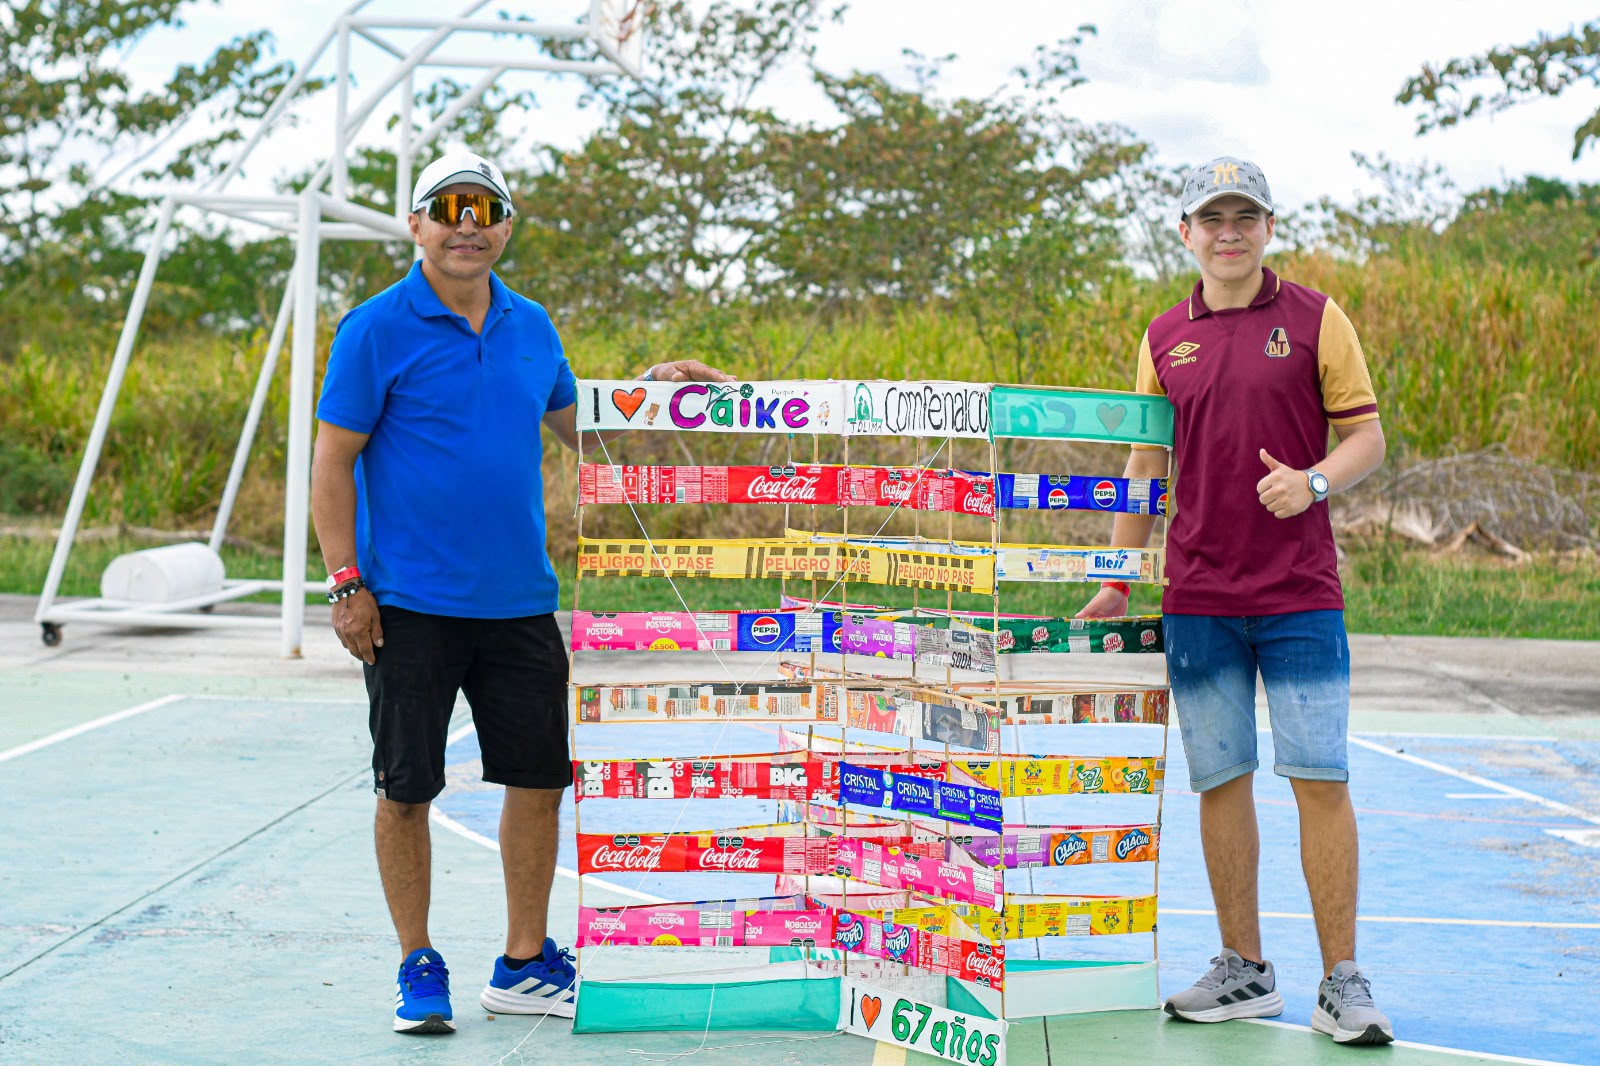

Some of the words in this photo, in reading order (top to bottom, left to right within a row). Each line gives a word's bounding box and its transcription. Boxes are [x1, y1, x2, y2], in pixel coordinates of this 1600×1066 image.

[1171, 356, 1196, 368] umbro
[594, 388, 600, 424] I
[885, 386, 988, 433] Comfenalco
[850, 422, 882, 433] TOLIMA
[747, 476, 820, 500] Coca-Cola
[578, 556, 645, 569] PELIGRO
[650, 557, 671, 569] NO
[678, 557, 714, 570] PASE
[766, 558, 830, 571] PELIGRO
[850, 560, 870, 574] PASE
[1094, 555, 1124, 570] Bless
[898, 564, 934, 581] PELIGRO
[938, 568, 950, 582] NO
[952, 570, 974, 586] PASE
[586, 626, 623, 636] POSTOBÓN
[646, 619, 682, 630] POSTOBÓN
[950, 652, 972, 670] SODA
[584, 762, 604, 796] BIG
[692, 776, 715, 788] BIG
[770, 766, 808, 786] BIG
[844, 772, 880, 790] CRISTAL
[897, 782, 932, 800] CRISTAL
[941, 786, 968, 800] CRISTAL
[976, 794, 1001, 806] CRISTA
[986, 845, 1014, 856] POSTBÓN
[1054, 840, 1088, 862] GLACIAL
[1116, 836, 1150, 858] GLACIAL
[591, 845, 661, 868] Coca-Cola
[699, 848, 763, 869] Coca-Cola
[938, 866, 967, 883] POSTOBÓN
[589, 920, 626, 931] POSTOBÓN
[648, 914, 684, 926] POSTOBÓN
[785, 919, 821, 930] POSTOBÓN
[966, 951, 1004, 978] Coca-Cola
[850, 987, 855, 1026] I
[891, 998, 932, 1044] 67
[930, 1016, 1000, 1066] años
